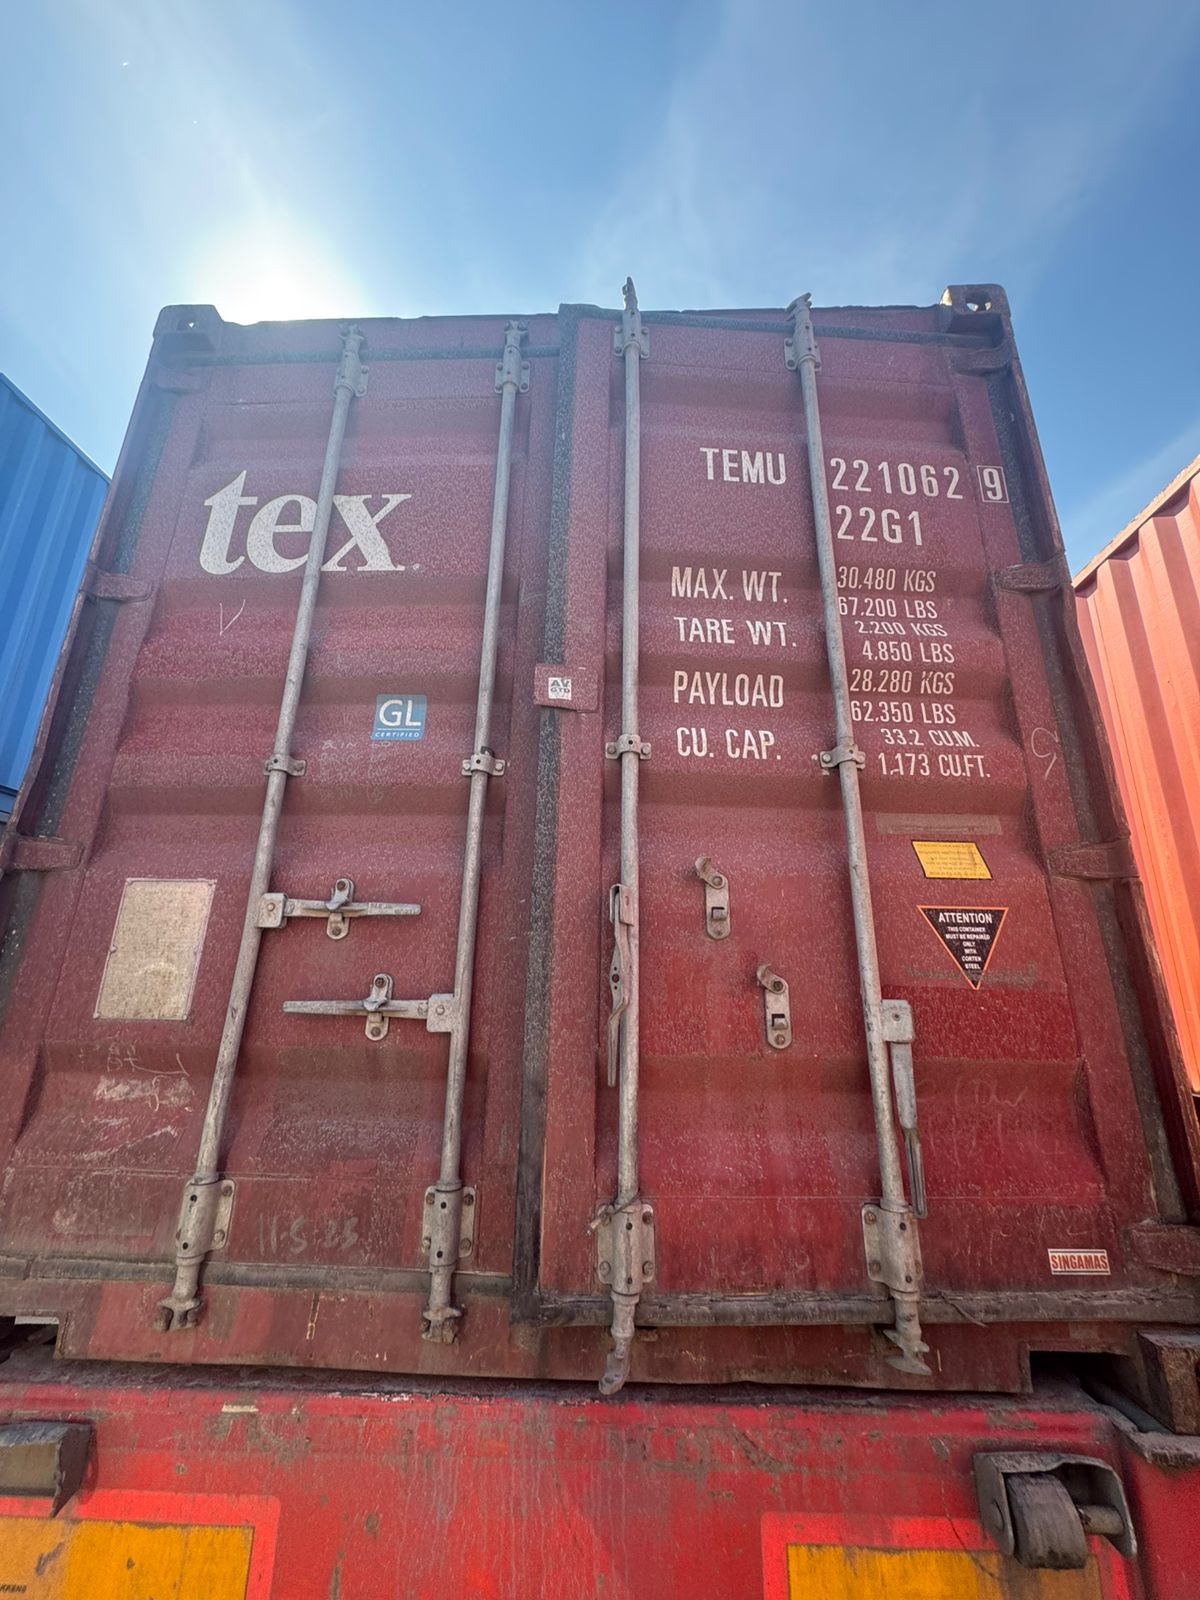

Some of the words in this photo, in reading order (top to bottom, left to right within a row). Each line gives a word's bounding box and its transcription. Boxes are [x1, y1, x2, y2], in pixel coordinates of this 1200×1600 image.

[700, 447, 787, 486] TEMU
[830, 457, 963, 499] 221062
[982, 468, 1003, 501] 9
[199, 470, 412, 575] tex
[835, 504, 922, 546] 22G1
[671, 566, 733, 600] MAX.
[742, 570, 787, 603] WT.
[903, 569, 936, 593] KGS
[904, 599, 938, 619] LBS
[673, 616, 735, 644] TARE
[745, 620, 797, 647] WT.
[910, 622, 948, 637] KGS
[919, 642, 955, 664] LBS
[673, 670, 784, 708] PAYLOAD
[920, 670, 955, 695] KGS
[379, 699, 422, 727] GL
[920, 702, 956, 724] LBS
[676, 727, 714, 758] CU.
[725, 729, 781, 760] CAP.
[880, 728, 925, 746] 33.2
[939, 912, 992, 923] ATTENTION
[1051, 1255, 1107, 1269] SINGAMAS
